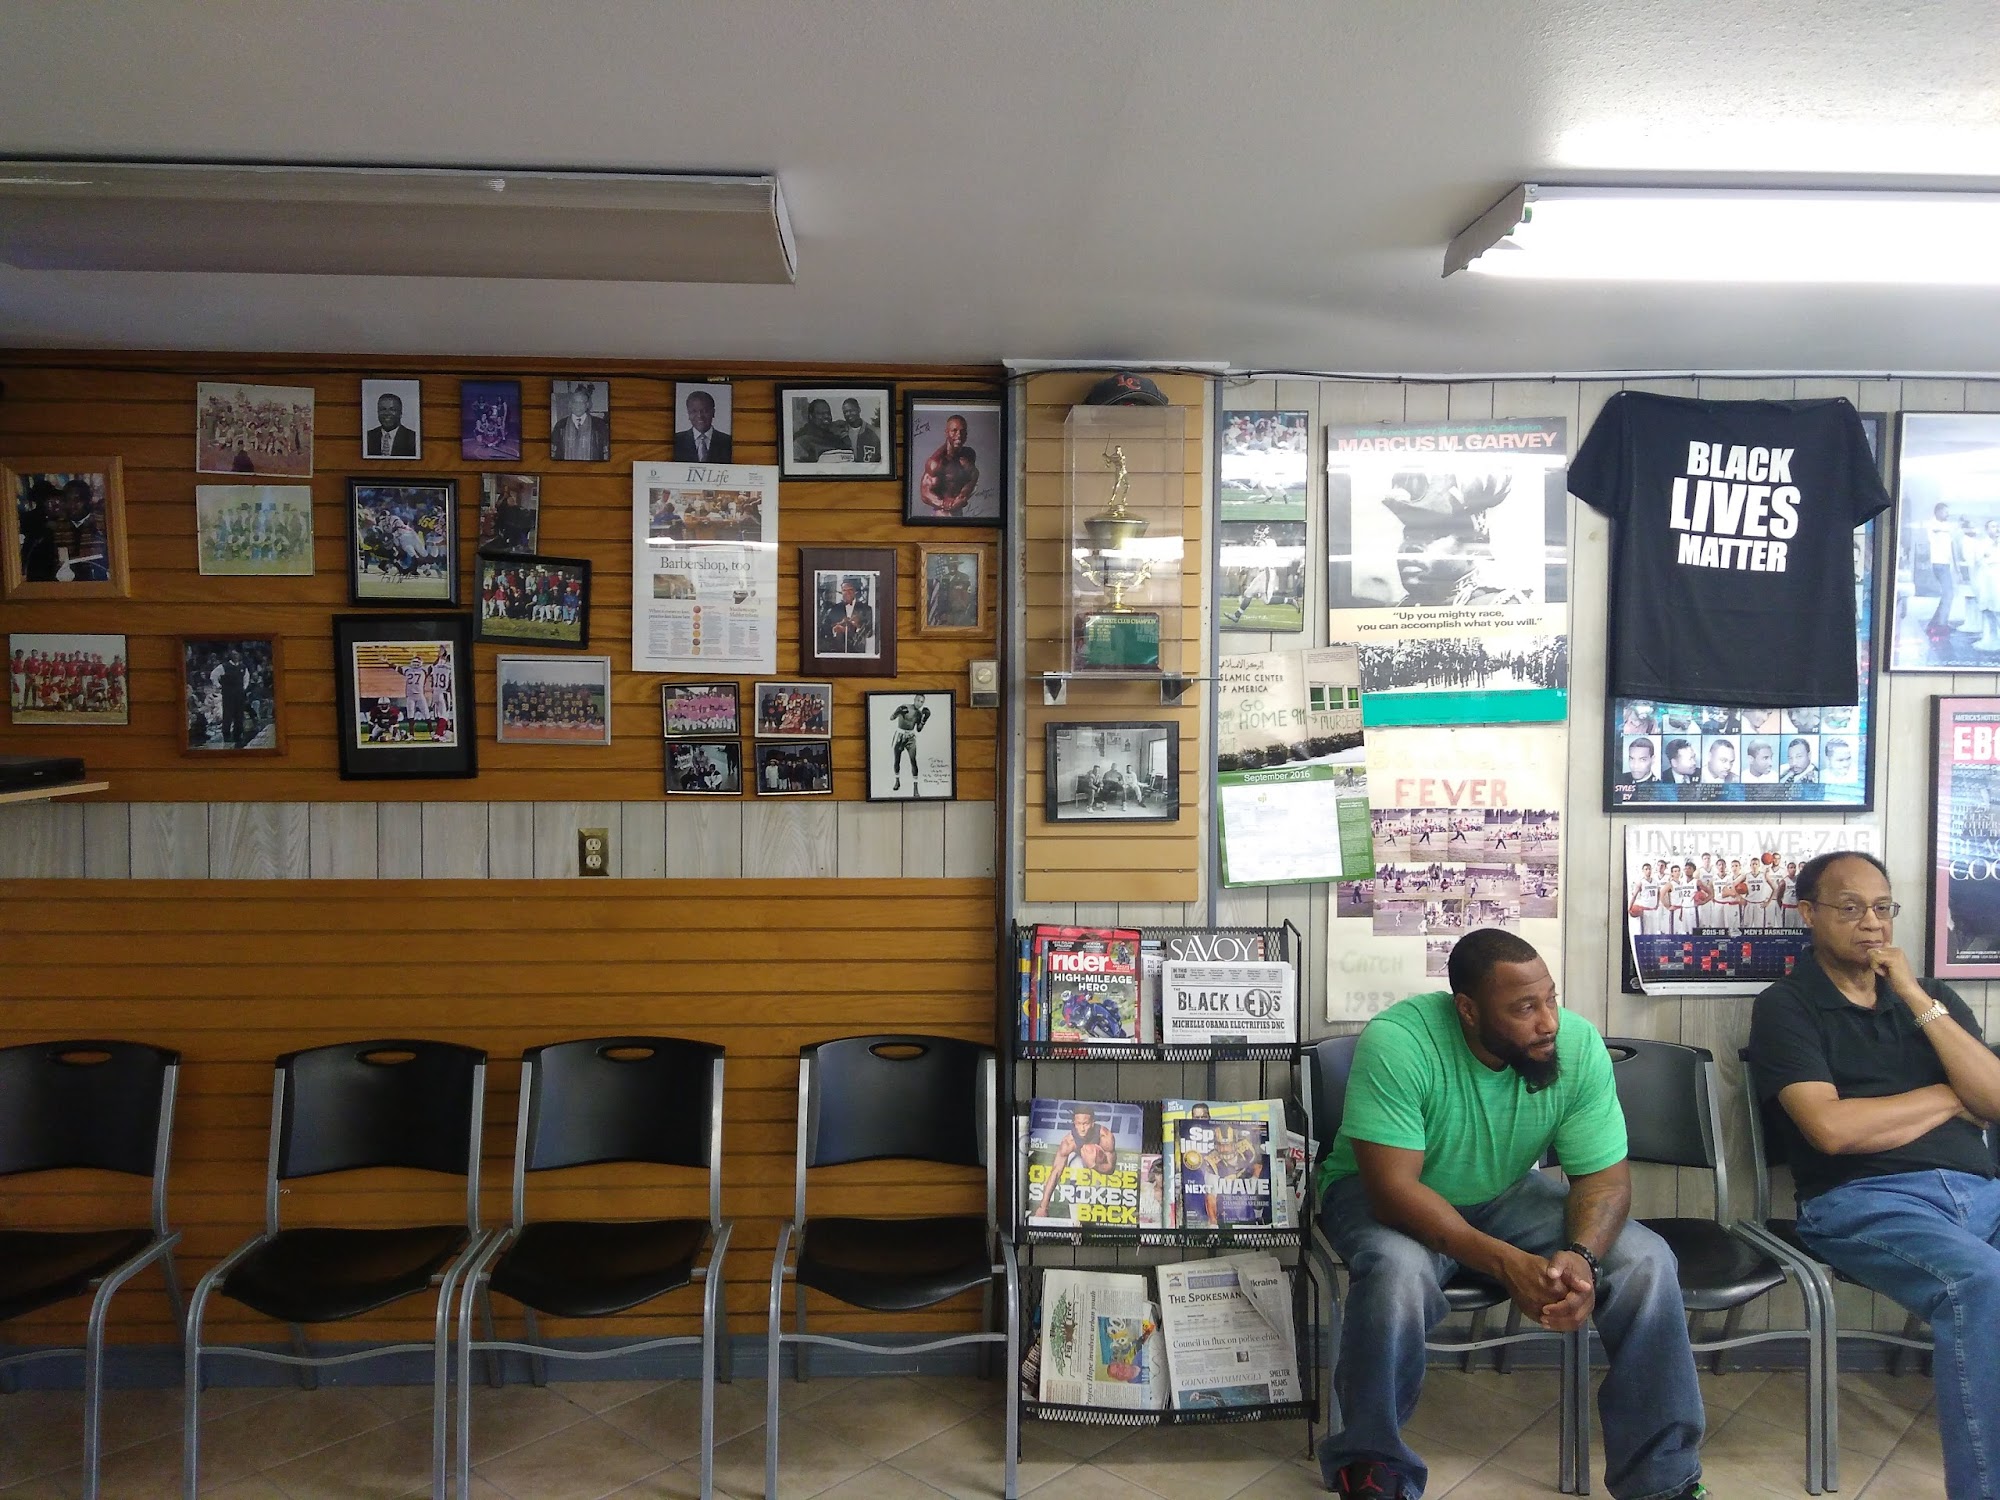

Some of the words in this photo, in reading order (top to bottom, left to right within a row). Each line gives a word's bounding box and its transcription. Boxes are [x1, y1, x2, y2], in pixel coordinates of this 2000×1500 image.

[1338, 435, 1436, 453] MARCUS
[1466, 431, 1558, 450] GARVEY
[1686, 440, 1795, 483] BLACK
[686, 469, 706, 482] IN
[707, 469, 729, 486] Life
[1669, 477, 1802, 540] LIVES
[1677, 533, 1788, 573] MATTER
[661, 556, 729, 571] Barbershop,
[731, 559, 751, 571] too
[1417, 612, 1437, 620] you
[1438, 610, 1476, 619] mighty
[1479, 610, 1505, 618] race,
[1357, 623, 1377, 631] you
[1378, 622, 1399, 630] can
[1400, 620, 1462, 630] accomplish
[1463, 619, 1492, 628] what
[1494, 619, 1515, 628] you
[407, 674, 421, 685] 27
[1219, 674, 1251, 683] SLAMIC
[1254, 674, 1284, 683] CENTER
[1231, 685, 1268, 693] AMERICA
[1240, 700, 1264, 712] GO
[1239, 710, 1287, 729] HOME
[1292, 709, 1306, 725] 911
[1244, 772, 1289, 783] September
[1290, 770, 1310, 779] 2016
[1394, 778, 1509, 808] FEVER
[1968, 829, 1987, 837] ALL
[1632, 831, 1743, 856] UNITED
[1755, 831, 1803, 855] WE
[1814, 831, 1871, 853] ZAG
[1702, 928, 1725, 936] 2015-16
[1743, 928, 1763, 936] MEN'S
[1764, 928, 1804, 936] BASKETBALL
[1169, 934, 1255, 962] SAVOY
[1052, 951, 1109, 972] rider
[1078, 984, 1108, 992] HERO
[1178, 991, 1230, 1012] BLACK
[1172, 1020, 1205, 1029] MICHELLE
[1205, 1020, 1229, 1029] OBAMA
[1230, 1021, 1271, 1029] ELECTRIFIES
[1271, 1021, 1285, 1030] DNC
[1117, 1162, 1138, 1171] THE
[1185, 1184, 1213, 1194] NEXT
[1213, 1178, 1270, 1195] WAVE
[1077, 1204, 1138, 1224] BACK
[1089, 1290, 1097, 1310] youth
[1168, 1294, 1187, 1304] THE
[1173, 1337, 1201, 1349] Council
[1202, 1338, 1210, 1346] in
[1211, 1336, 1226, 1346] flux
[1238, 1335, 1261, 1346] police
[1065, 1342, 1073, 1359] Fig
[1181, 1376, 1208, 1387] GOING
[1208, 1372, 1262, 1384] SWIMMINGLY
[1269, 1369, 1291, 1378] SMELTER
[1271, 1378, 1288, 1388] MEANS
[1272, 1388, 1285, 1396] JOBS
